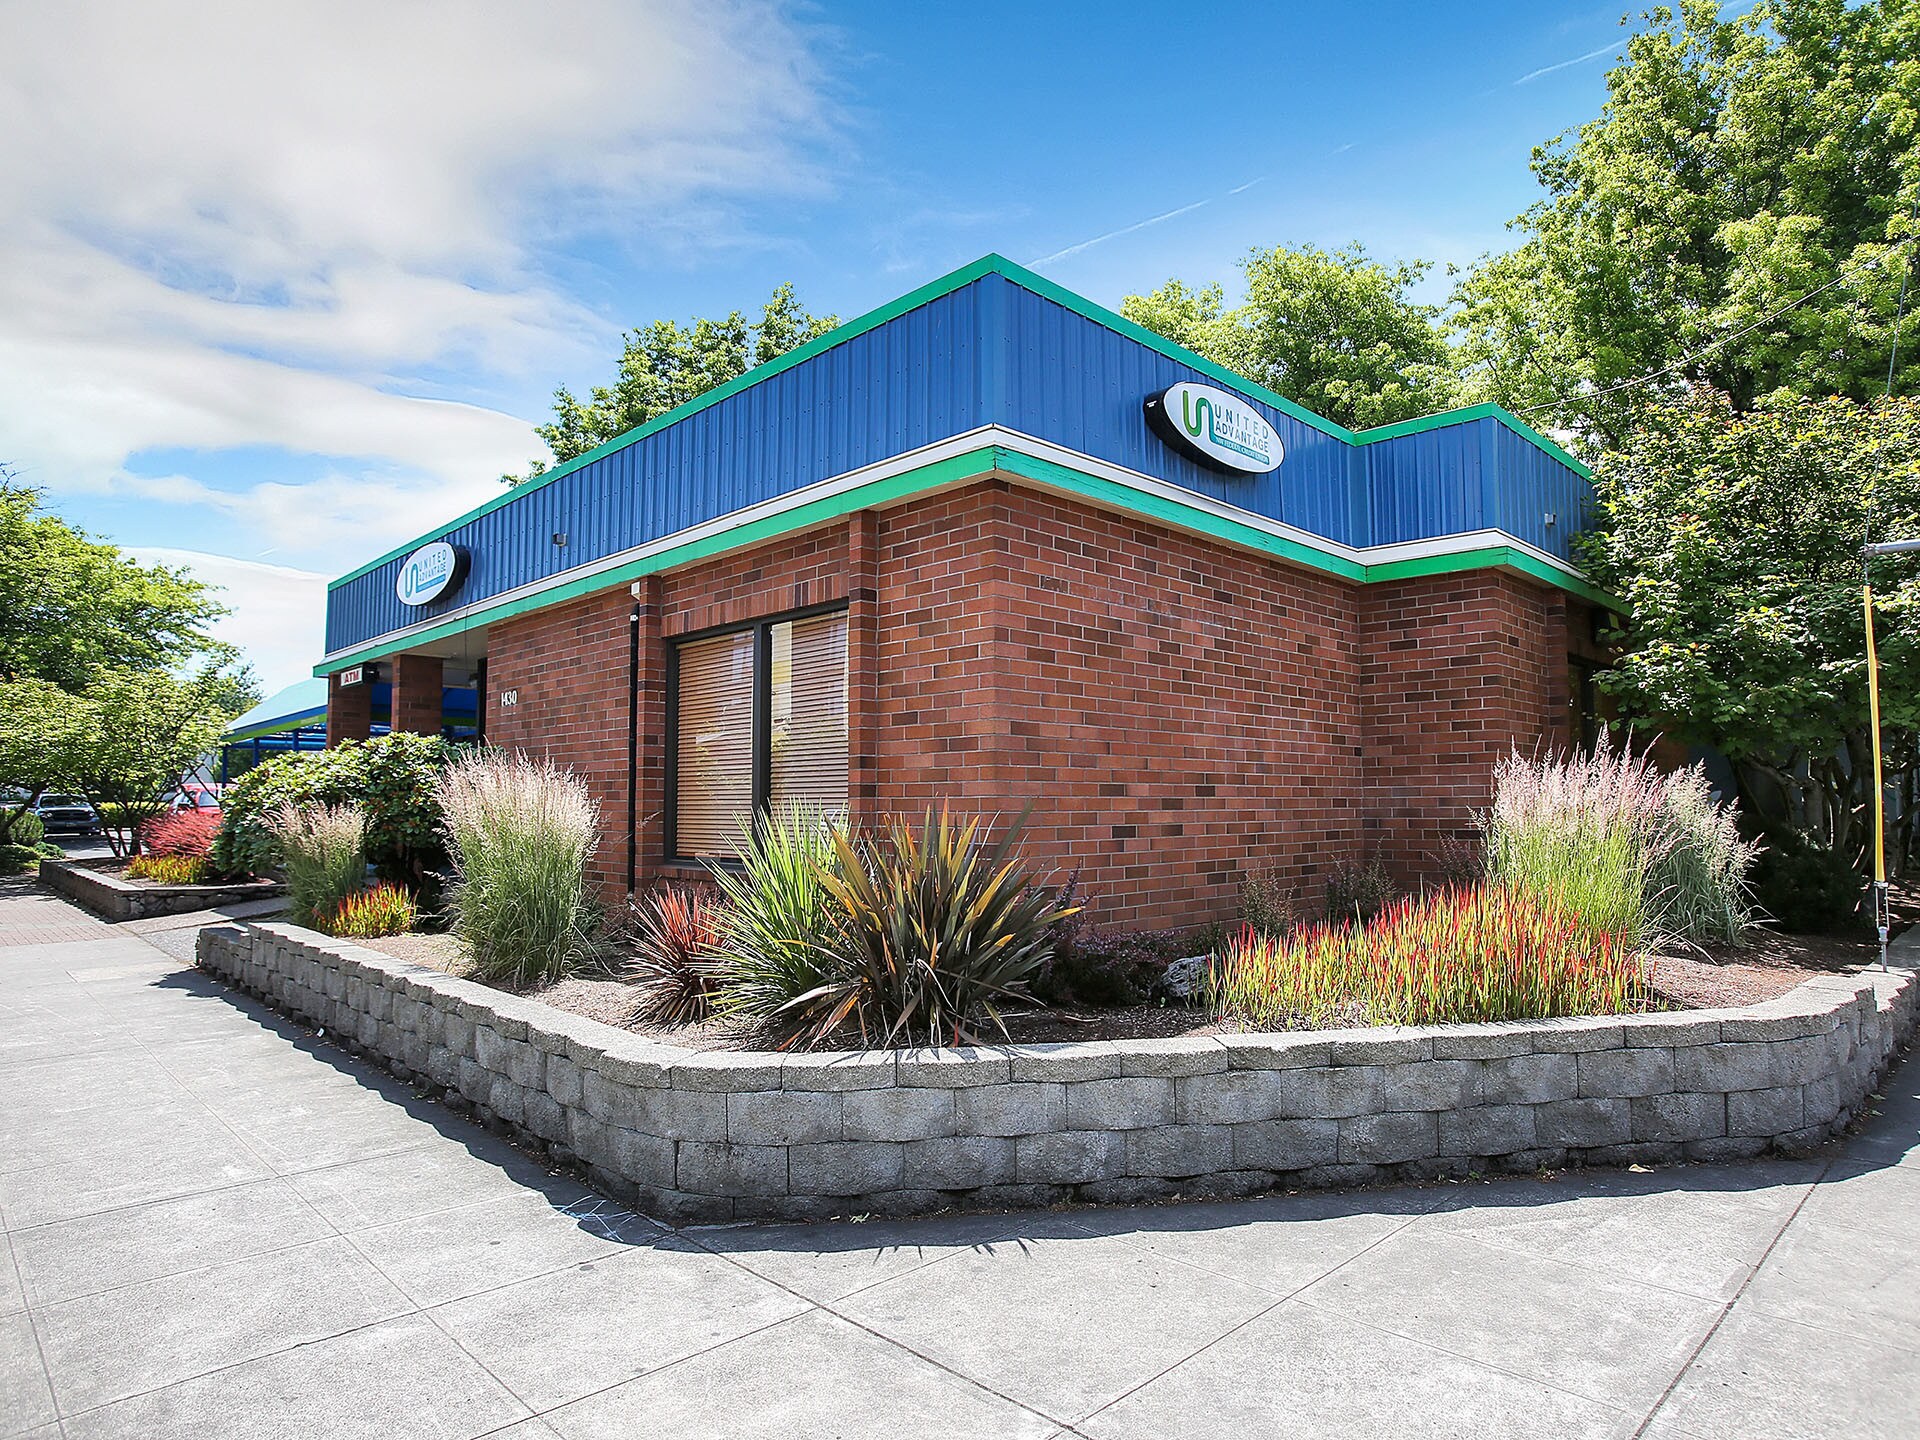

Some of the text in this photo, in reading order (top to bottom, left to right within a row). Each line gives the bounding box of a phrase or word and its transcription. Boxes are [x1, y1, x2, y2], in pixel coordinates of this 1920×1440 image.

[1214, 403, 1269, 440] UNITED
[1215, 420, 1269, 453] ADVANTAGE
[419, 549, 446, 570] UNITED
[344, 670, 359, 683] ATM
